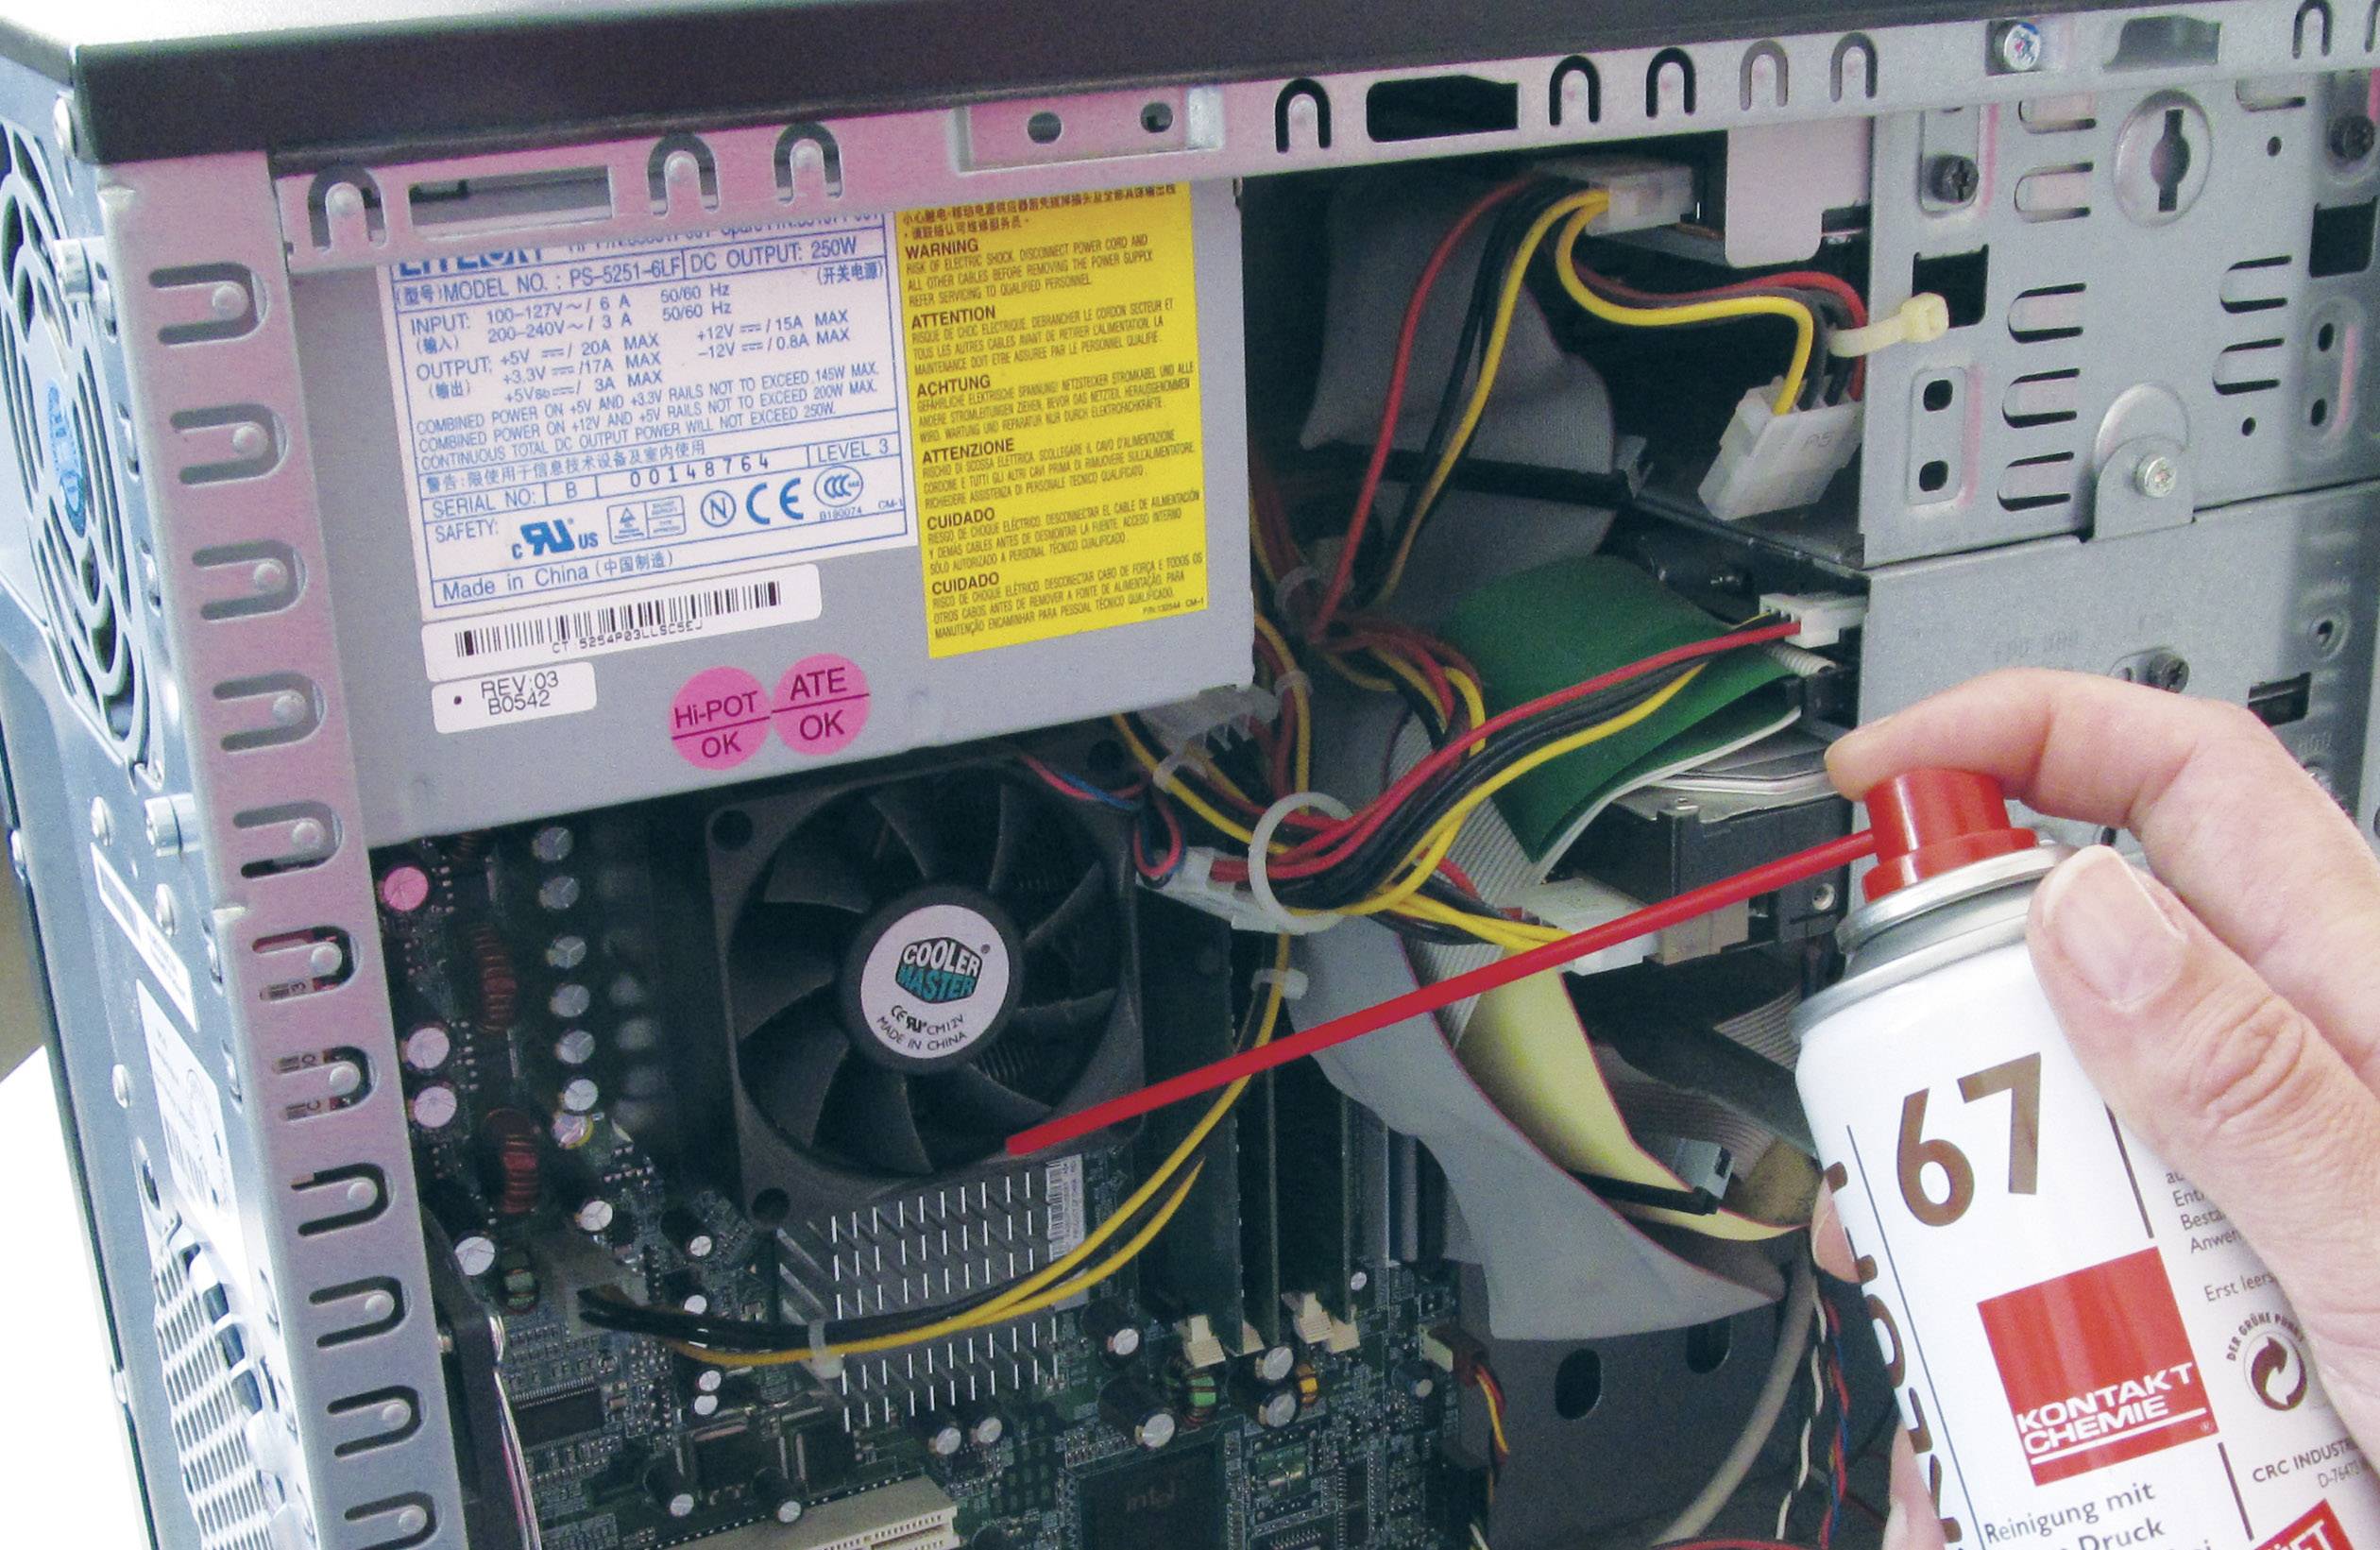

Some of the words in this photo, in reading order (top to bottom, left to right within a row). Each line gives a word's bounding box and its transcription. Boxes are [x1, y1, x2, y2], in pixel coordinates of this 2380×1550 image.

[689, 250, 717, 273] DC
[726, 241, 802, 268] OUTPUT:
[810, 235, 856, 259] 250W
[905, 237, 978, 260] WARNING
[443, 277, 508, 301] MODEL
[516, 271, 547, 293] NO.
[569, 257, 679, 287] PS-5251-6LF
[907, 277, 923, 292] ALL
[1071, 256, 1087, 270] THE
[984, 283, 996, 298] TO
[410, 312, 469, 335] INPUT:
[599, 296, 610, 311] 6
[619, 293, 630, 308] A
[660, 284, 701, 303] 50/60
[709, 281, 729, 297] Hz
[602, 314, 611, 330] 3
[620, 311, 632, 326] A
[662, 302, 703, 321] 50/60
[711, 300, 731, 315] Hz
[911, 305, 995, 330] ATTENTION
[416, 355, 491, 381] OUTPUT:
[500, 348, 529, 366] +5V
[581, 338, 611, 356] 20A
[622, 332, 658, 350] MAX
[697, 323, 734, 340] +12V
[775, 315, 803, 331] 15A
[814, 309, 847, 326] MAX
[502, 366, 545, 384] +3.3V
[624, 350, 660, 368] MAX
[698, 341, 735, 358] -12V
[775, 332, 809, 349] 0.8A
[816, 327, 849, 344] MAX
[594, 376, 615, 392] 3A
[627, 369, 662, 387] MAX
[916, 374, 990, 398] ACHTUNG
[416, 413, 484, 434] COMBINED
[491, 405, 537, 423] POWER
[544, 402, 564, 418] ON
[570, 398, 591, 414] +5V
[598, 394, 623, 410] AND
[630, 389, 661, 406] +3.3V
[668, 383, 704, 401] RAILS
[708, 379, 733, 396] NOT
[739, 376, 756, 392] TO
[760, 369, 808, 389] EXCEED
[815, 365, 844, 382] 145W
[418, 431, 486, 452] COMBINED
[493, 423, 540, 442] POWER
[546, 419, 565, 435] ON
[571, 415, 600, 432] +12V
[606, 410, 633, 427] AND
[638, 406, 660, 422] +5V
[667, 400, 702, 417] RAILS
[707, 397, 731, 414] NOT
[737, 394, 754, 409] TO
[759, 387, 808, 407] EXCEED
[813, 382, 842, 400] 200W
[420, 445, 505, 470] CONTINUOUS
[511, 440, 549, 457] TOTAL
[553, 435, 572, 453] DC
[578, 428, 628, 450] OUTPUT
[635, 421, 680, 440] POWER
[685, 417, 713, 434] WILL
[719, 412, 743, 431] NOT
[750, 405, 798, 427] EXCEED
[816, 440, 871, 463] LEVEL
[878, 437, 890, 455] 3
[922, 437, 1013, 464] ATTENZIONE
[431, 490, 496, 519] SERIAL
[503, 484, 536, 507] NO:
[565, 480, 577, 500] B
[745, 477, 803, 524] CE
[434, 518, 498, 543] SAFETY:
[926, 506, 994, 530] CUIDADO
[442, 577, 495, 601] Made
[506, 572, 523, 590] in
[535, 565, 588, 587] China
[931, 571, 999, 595] CUIDADO
[790, 667, 849, 702] ATE
[488, 690, 552, 716] B0542
[673, 691, 758, 729] Hi-POT
[798, 710, 846, 741] OK
[701, 734, 740, 759] OK
[903, 939, 982, 978] COOLER
[896, 964, 976, 1001] MASTER
[876, 1016, 906, 1044] MADE
[908, 1038, 922, 1050] IN
[927, 1031, 967, 1050] CHINA
[1896, 1051, 2042, 1227] 67
[2204, 1280, 2238, 1302] Erst
[2226, 1336, 2241, 1361] DER
[2238, 1312, 2271, 1336] GRÜNE
[2015, 1362, 2196, 1434] KONTAKT
[2023, 1395, 2169, 1456] CHEMIE
[2252, 1459, 2289, 1483] CRC
[1983, 1501, 2100, 1544] Reinigung
[2105, 1482, 2155, 1512] mit
